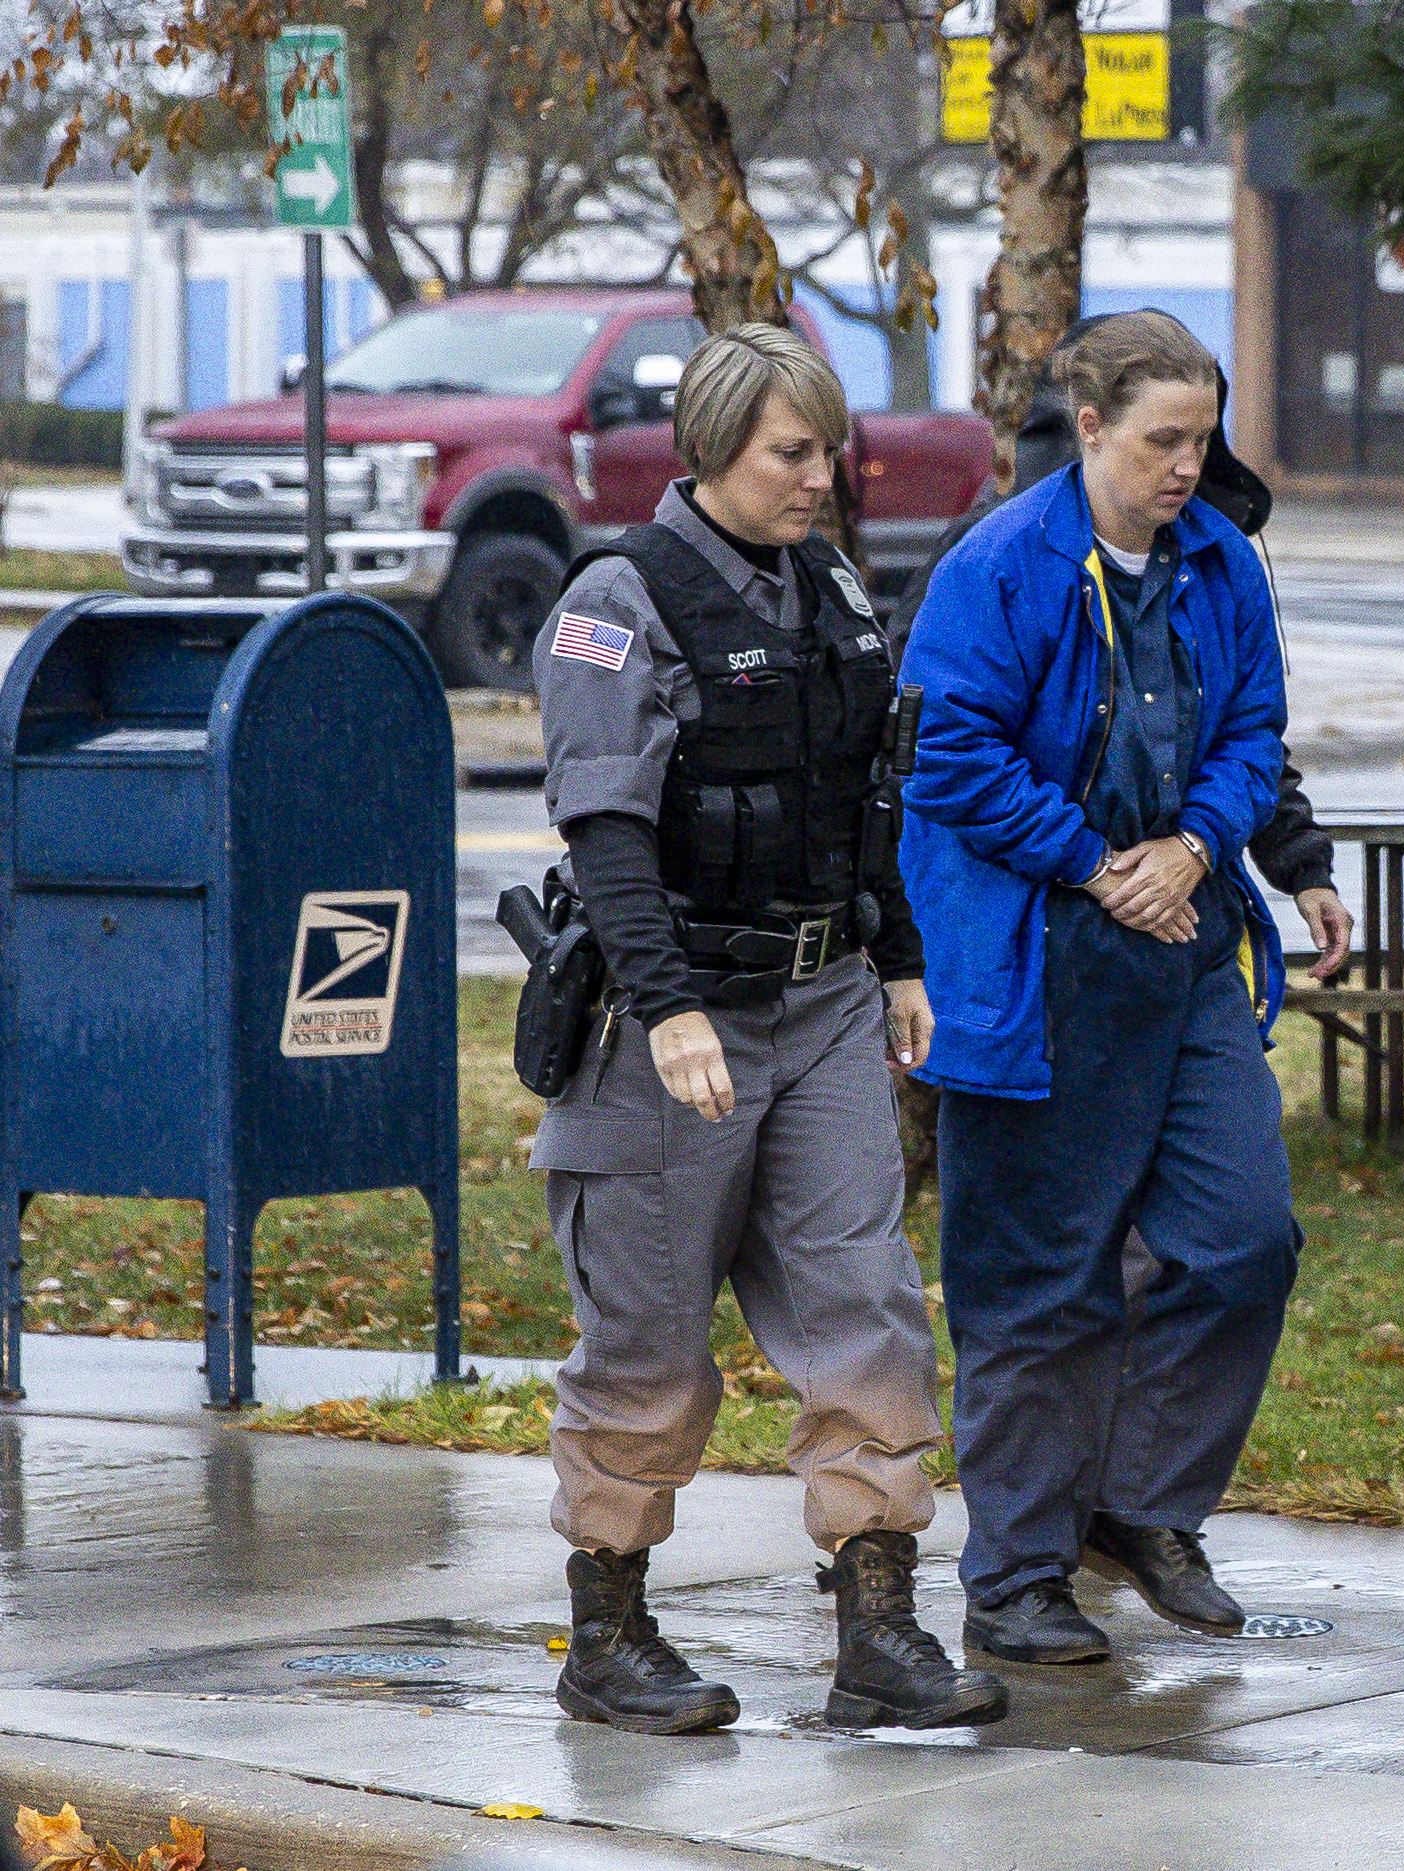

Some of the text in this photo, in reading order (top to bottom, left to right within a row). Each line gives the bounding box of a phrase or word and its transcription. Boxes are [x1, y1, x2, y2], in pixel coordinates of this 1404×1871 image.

[728, 648, 768, 670] SCOTT
[290, 1008, 379, 1027] UNITED STATES
[287, 1028, 382, 1046] POSTAL SERVICE
